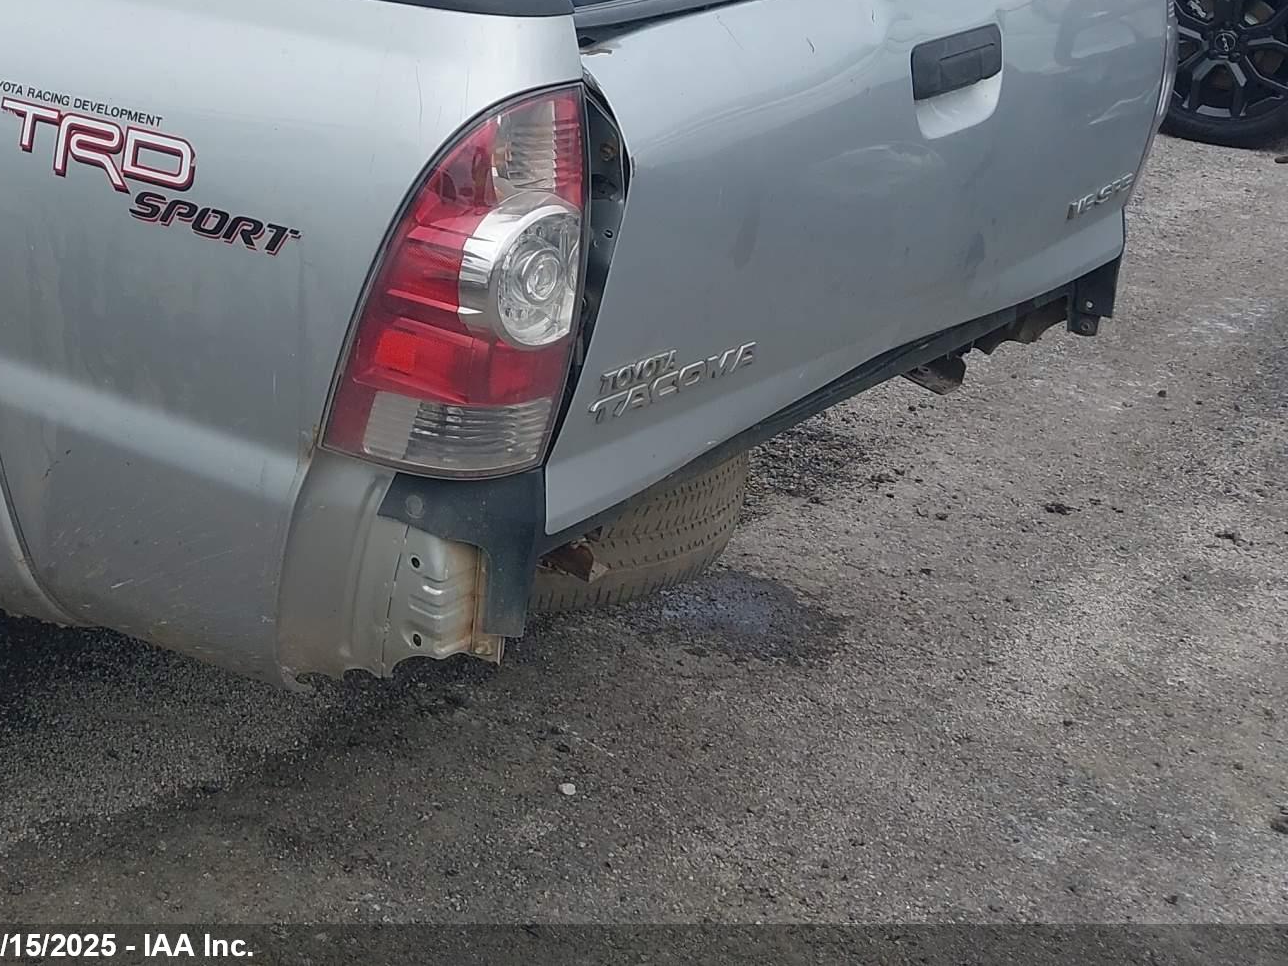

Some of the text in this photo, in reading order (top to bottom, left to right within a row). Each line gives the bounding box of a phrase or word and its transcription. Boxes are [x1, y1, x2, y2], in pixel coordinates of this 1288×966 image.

[26, 87, 70, 107] RACING
[73, 97, 163, 128] DEVELOPMENT
[1, 96, 196, 195] TRD
[128, 190, 301, 256] SPORT
[588, 341, 757, 423] TACOMA
[600, 349, 677, 394] TOYOTA
